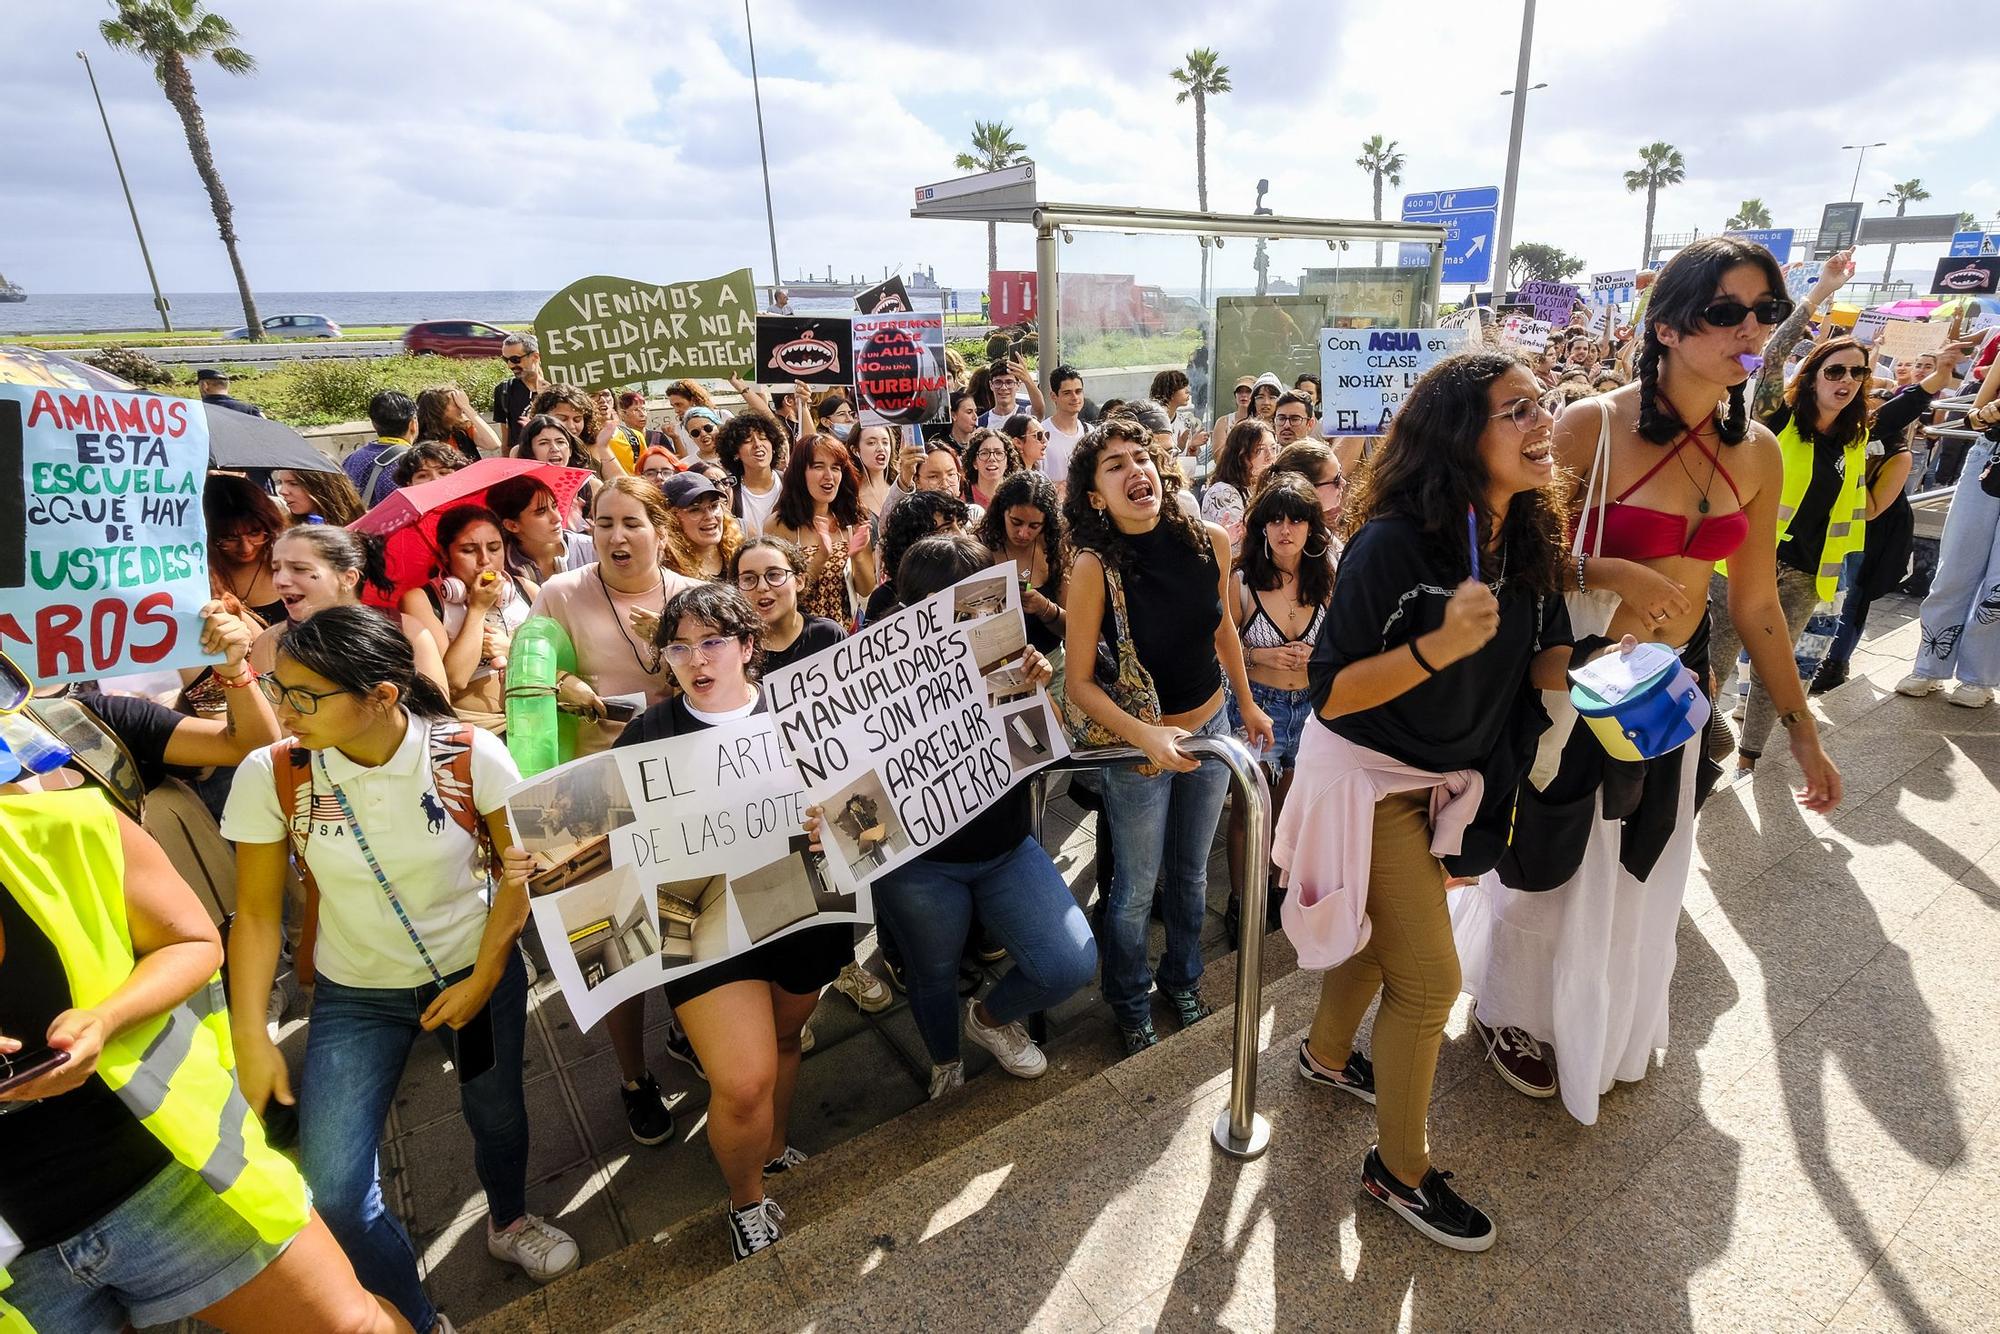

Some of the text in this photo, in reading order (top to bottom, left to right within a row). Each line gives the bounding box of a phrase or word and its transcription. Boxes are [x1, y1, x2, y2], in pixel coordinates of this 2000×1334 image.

[1407, 200, 1424, 208] 400
[1593, 282, 1634, 292] AGUJEROS
[1595, 276, 1612, 285] NO
[718, 284, 738, 307] A
[699, 314, 732, 337] NO
[854, 320, 942, 331] QUEREMOS
[880, 346, 925, 356] AULA
[1328, 332, 1446, 351] Con AGUA en
[548, 360, 604, 387] QUE
[856, 362, 880, 372] NO
[1367, 356, 1418, 368] CLASE
[857, 375, 947, 395] TURBINA
[1339, 376, 1361, 388] NO
[1364, 375, 1394, 388] HAY
[27, 390, 188, 437] AMAMOS
[76, 433, 169, 467] ESTA
[32, 463, 198, 495] ESCUELA
[141, 498, 190, 527] HAY
[106, 524, 134, 542] DE
[30, 541, 205, 590] USTEDES?
[767, 601, 943, 714] LAS CLASES DE
[780, 630, 968, 752] MANUALIDADES
[798, 663, 973, 788] NO SON PARA
[885, 703, 991, 798] ARREGLAR
[639, 753, 695, 803] EL
[901, 738, 1012, 847] GOTERAS
[632, 791, 805, 867] DE LAS GOTE
